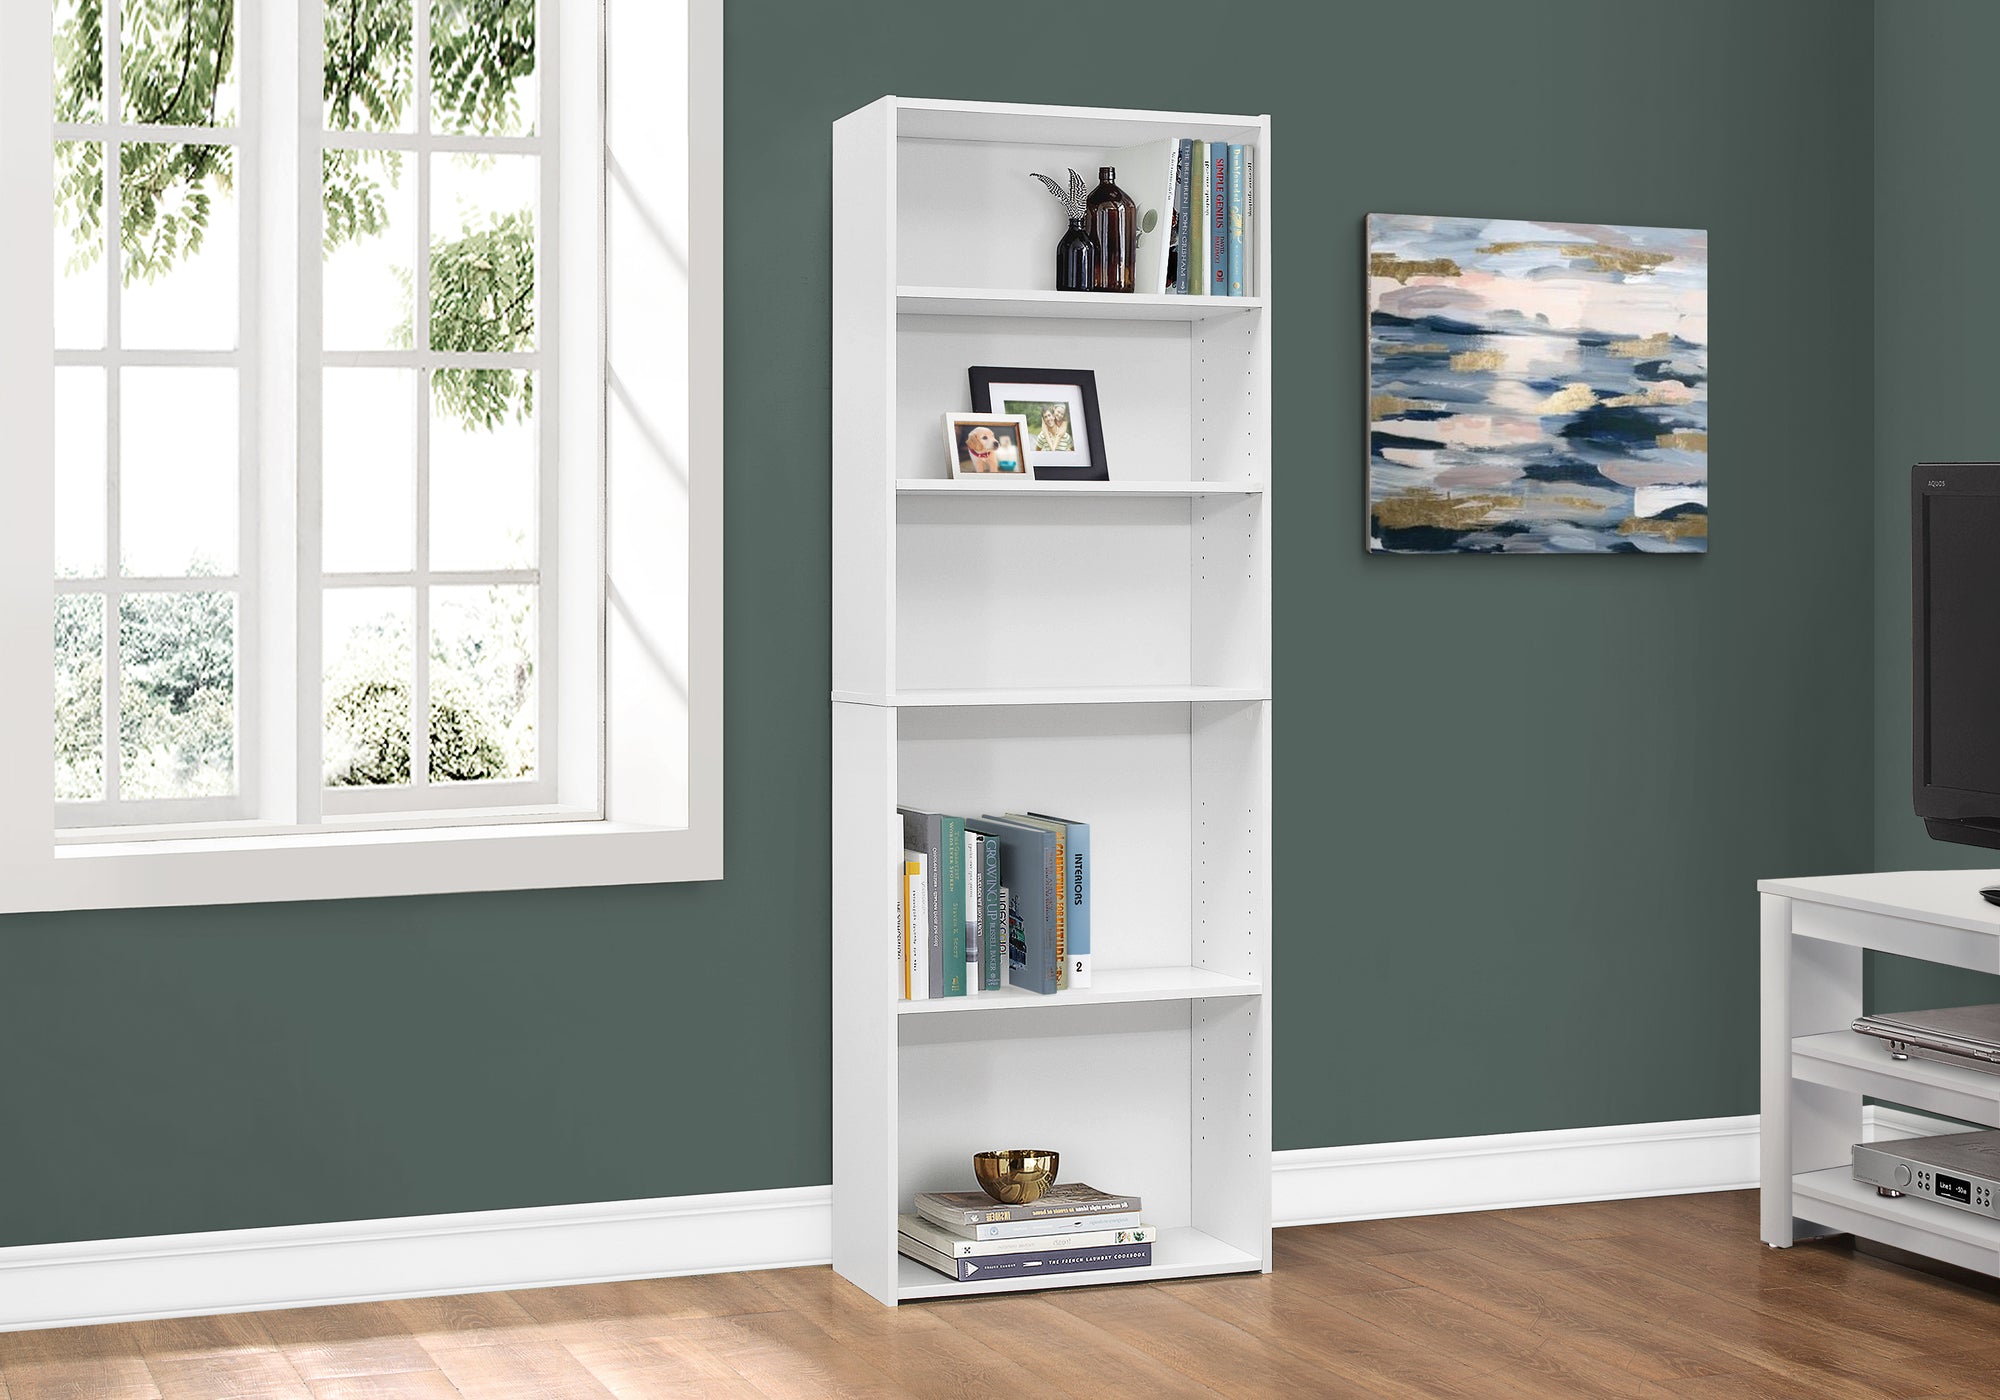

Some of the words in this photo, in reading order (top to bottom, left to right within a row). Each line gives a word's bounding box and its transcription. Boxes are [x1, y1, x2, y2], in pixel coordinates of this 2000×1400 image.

[1215, 158, 1224, 192] SIMPLE
[1215, 194, 1224, 229] GENIUS
[985, 839, 998, 903] GROWING
[1074, 853, 1083, 906] INTERIORS
[987, 903, 998, 921] UP
[1075, 961, 1083, 973] 2
[1113, 1251, 1146, 1260] COOKBOOK
